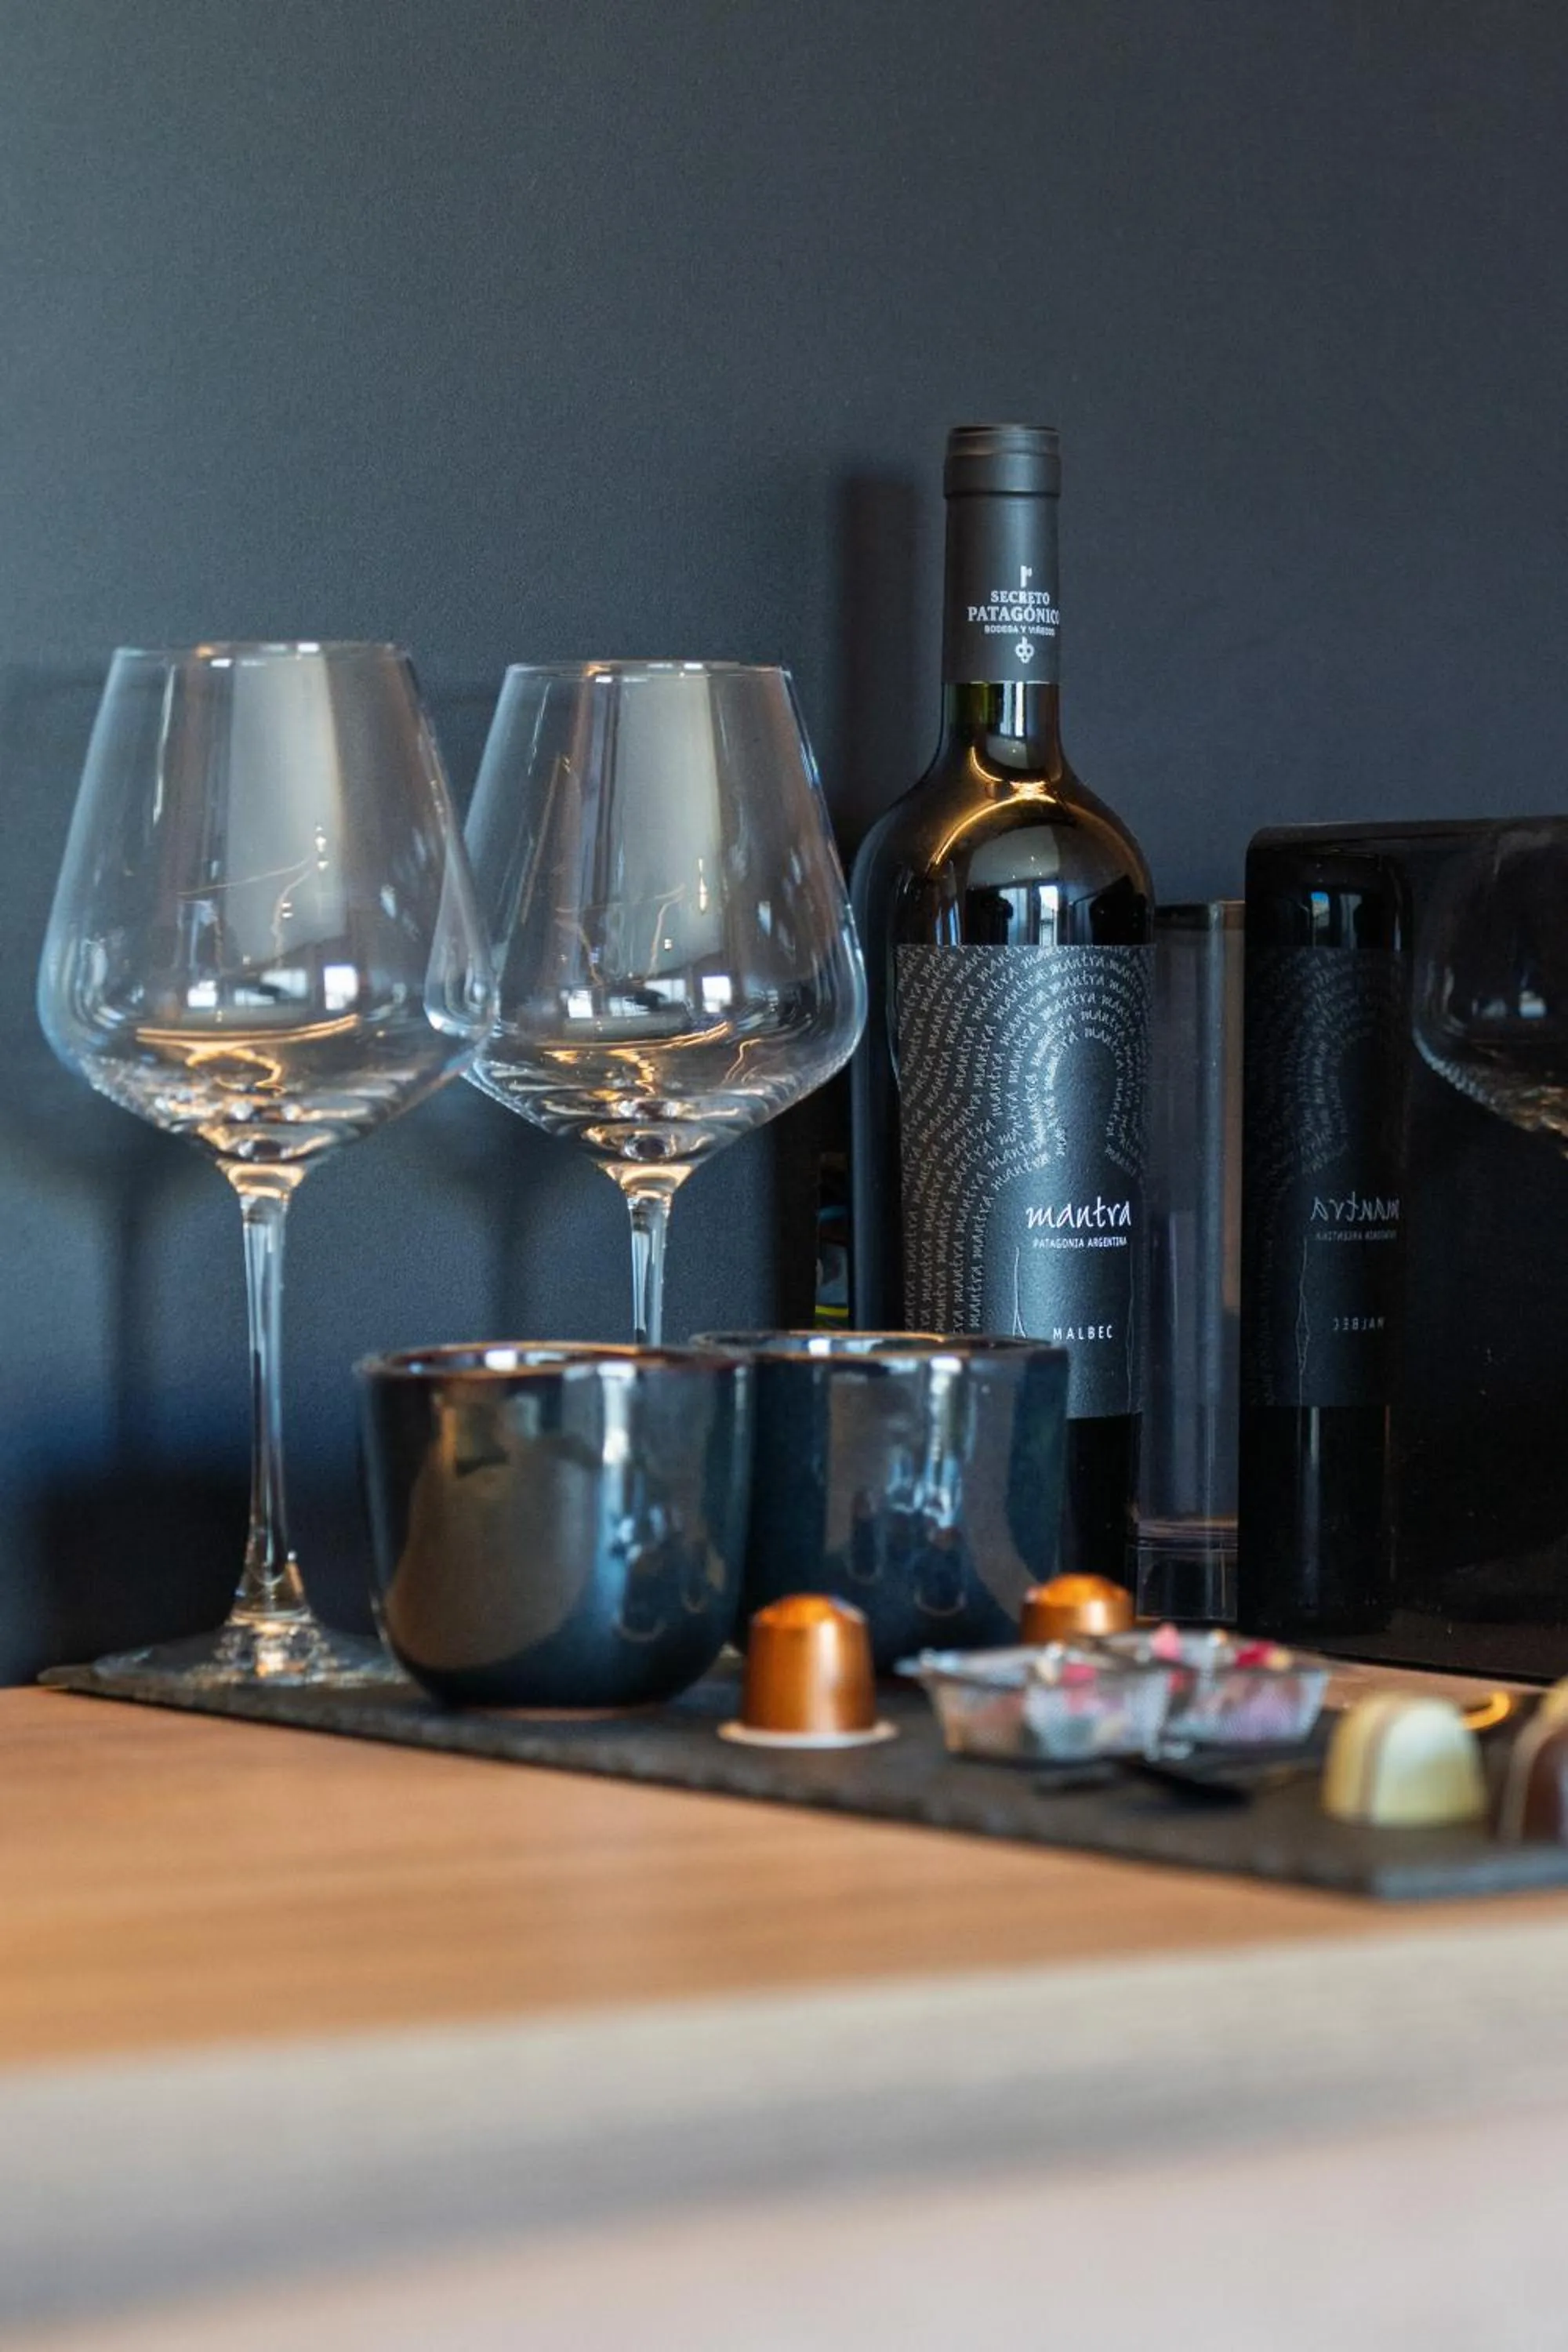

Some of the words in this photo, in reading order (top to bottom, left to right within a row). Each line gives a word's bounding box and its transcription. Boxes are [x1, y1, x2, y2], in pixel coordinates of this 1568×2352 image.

[990, 590, 1051, 606] SECRETO
[1020, 625, 1026, 633] Y
[1025, 1196, 1132, 1229] mantra
[1033, 1236, 1083, 1249] PATAGONIA
[1087, 1236, 1127, 1248] ARGENTINA
[1053, 1324, 1113, 1340] MALBEC
